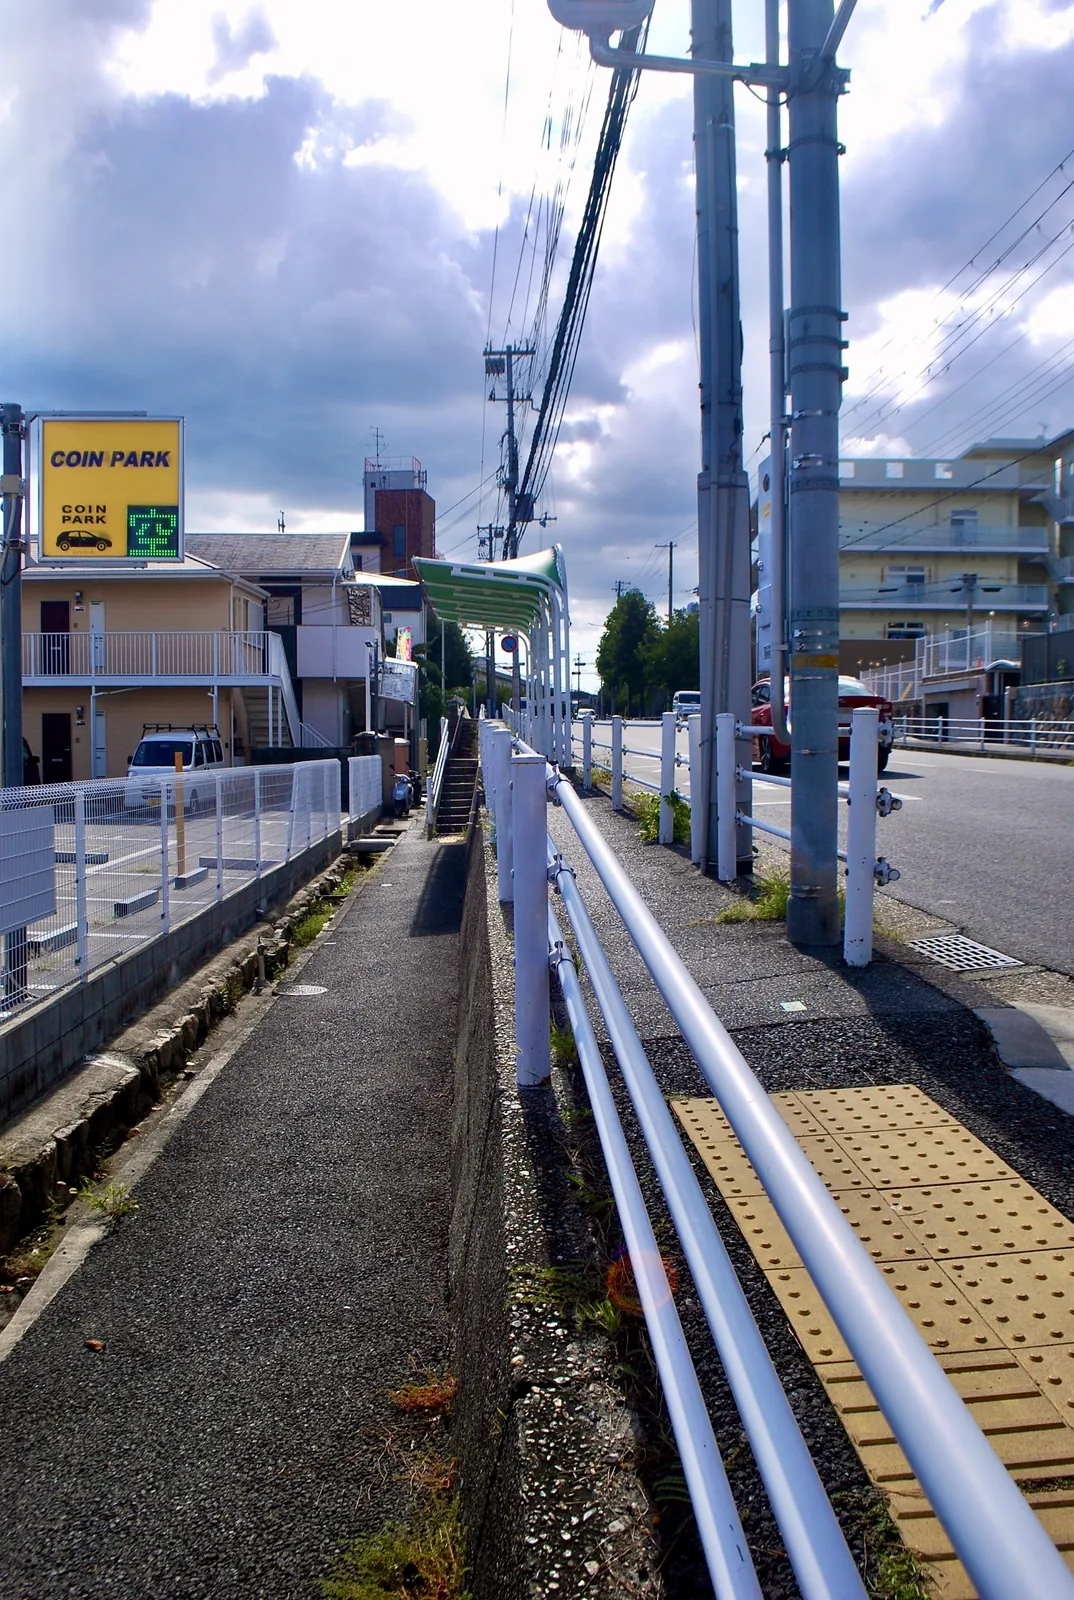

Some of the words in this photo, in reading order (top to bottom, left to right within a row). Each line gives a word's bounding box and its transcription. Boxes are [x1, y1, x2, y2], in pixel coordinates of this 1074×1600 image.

[50, 450, 105, 468] COIN
[110, 450, 171, 468] PARK
[61, 504, 107, 514] COIN
[61, 515, 107, 524] PARK
[129, 508, 177, 556] 空
